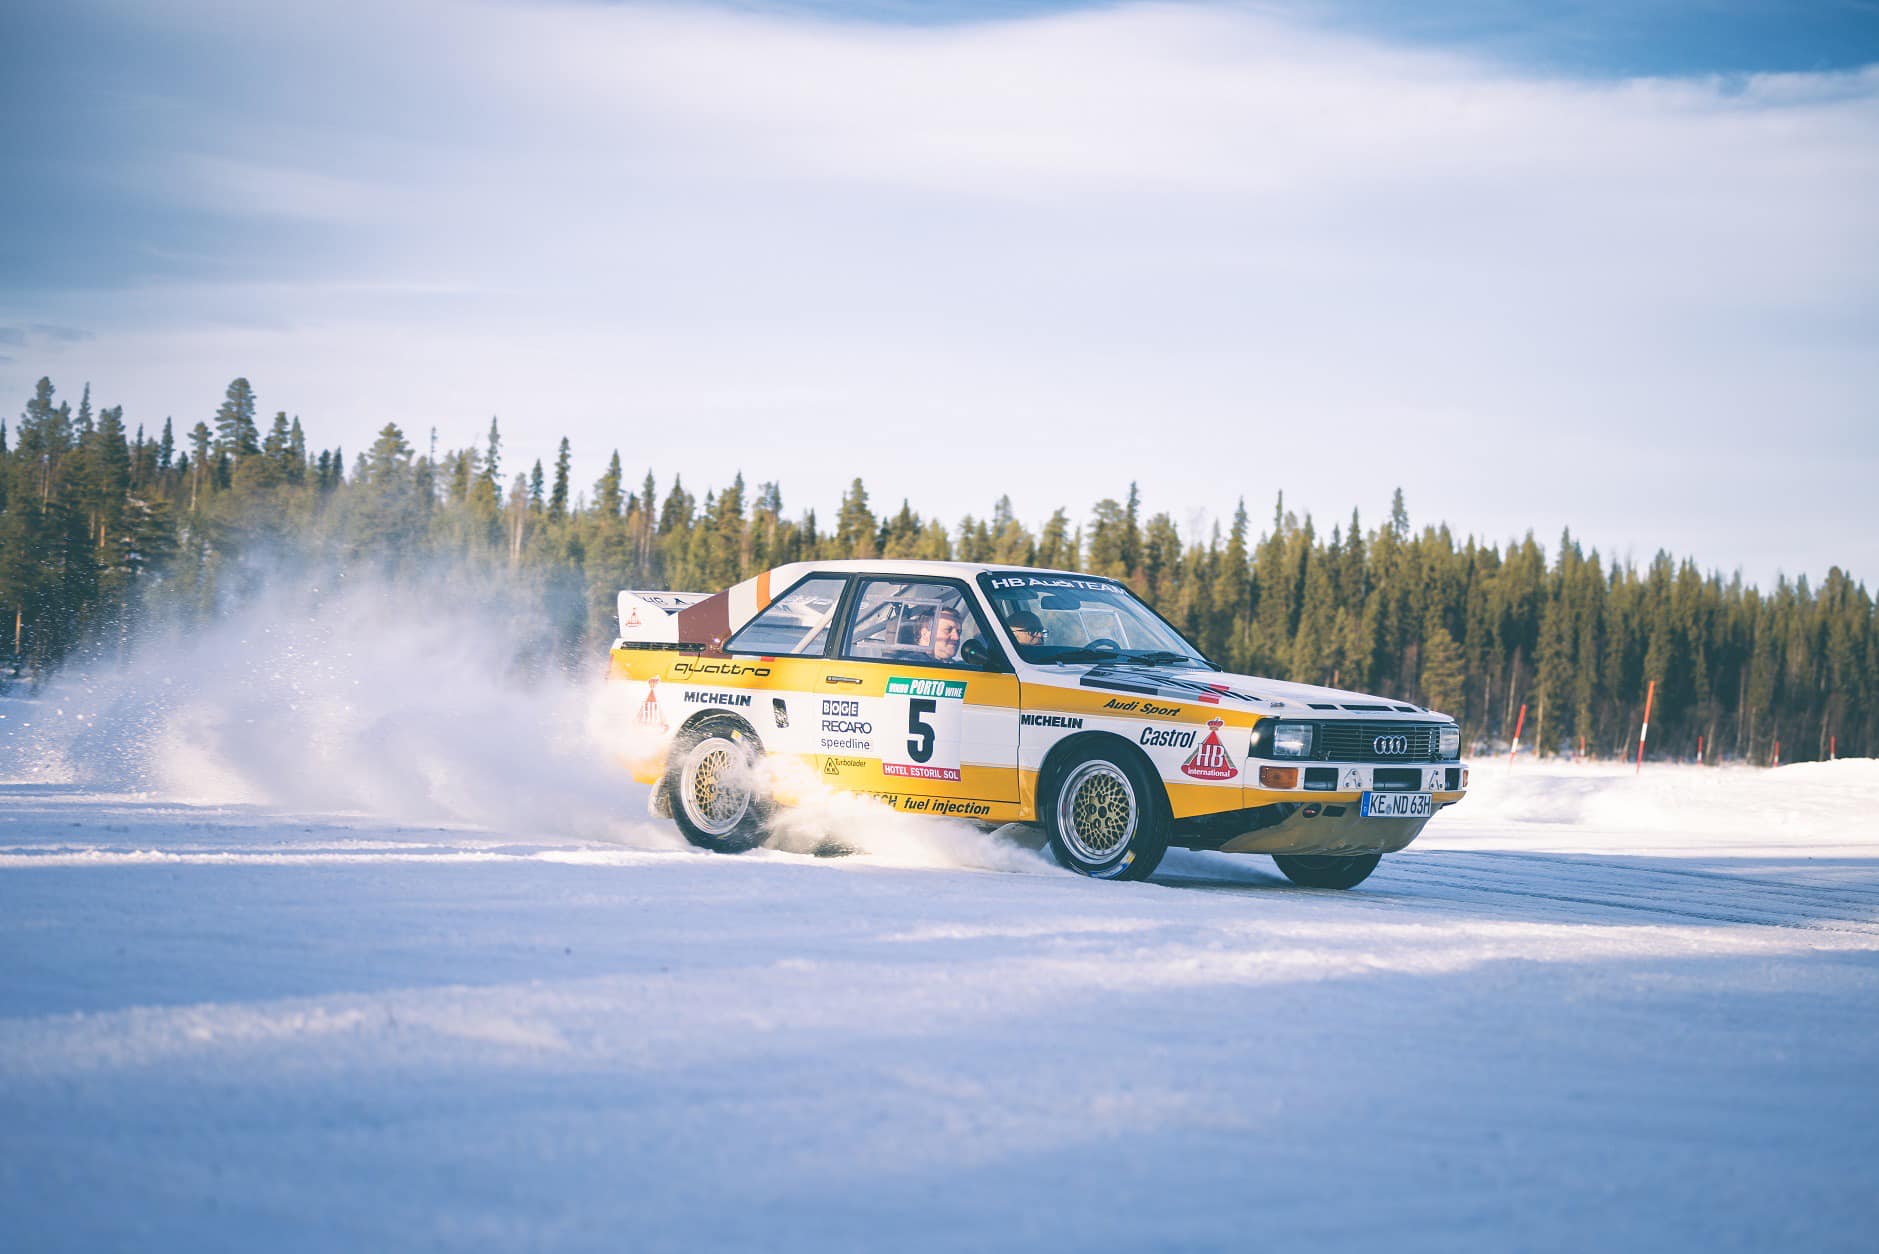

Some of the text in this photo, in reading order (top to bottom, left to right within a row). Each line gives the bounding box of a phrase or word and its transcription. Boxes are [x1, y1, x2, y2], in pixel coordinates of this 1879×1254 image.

[991, 578, 1025, 589] HB
[674, 663, 771, 677] quattro
[909, 680, 945, 697] PORTO
[945, 687, 963, 698] WINE
[684, 691, 752, 706] MICHELIN
[822, 700, 859, 716] BOGE
[1103, 698, 1181, 717] Audi Sport
[821, 720, 872, 734] RECARO
[1021, 714, 1083, 729] MICHELIN
[907, 698, 937, 763] 5
[1140, 726, 1197, 748] Castrol
[821, 738, 870, 750] speedline
[1196, 742, 1225, 768] HB
[884, 764, 959, 780] HOTEL ESTORIL SOL
[903, 797, 930, 811] fuel
[932, 799, 991, 815] injection
[1370, 795, 1431, 815] KE ND 63H
